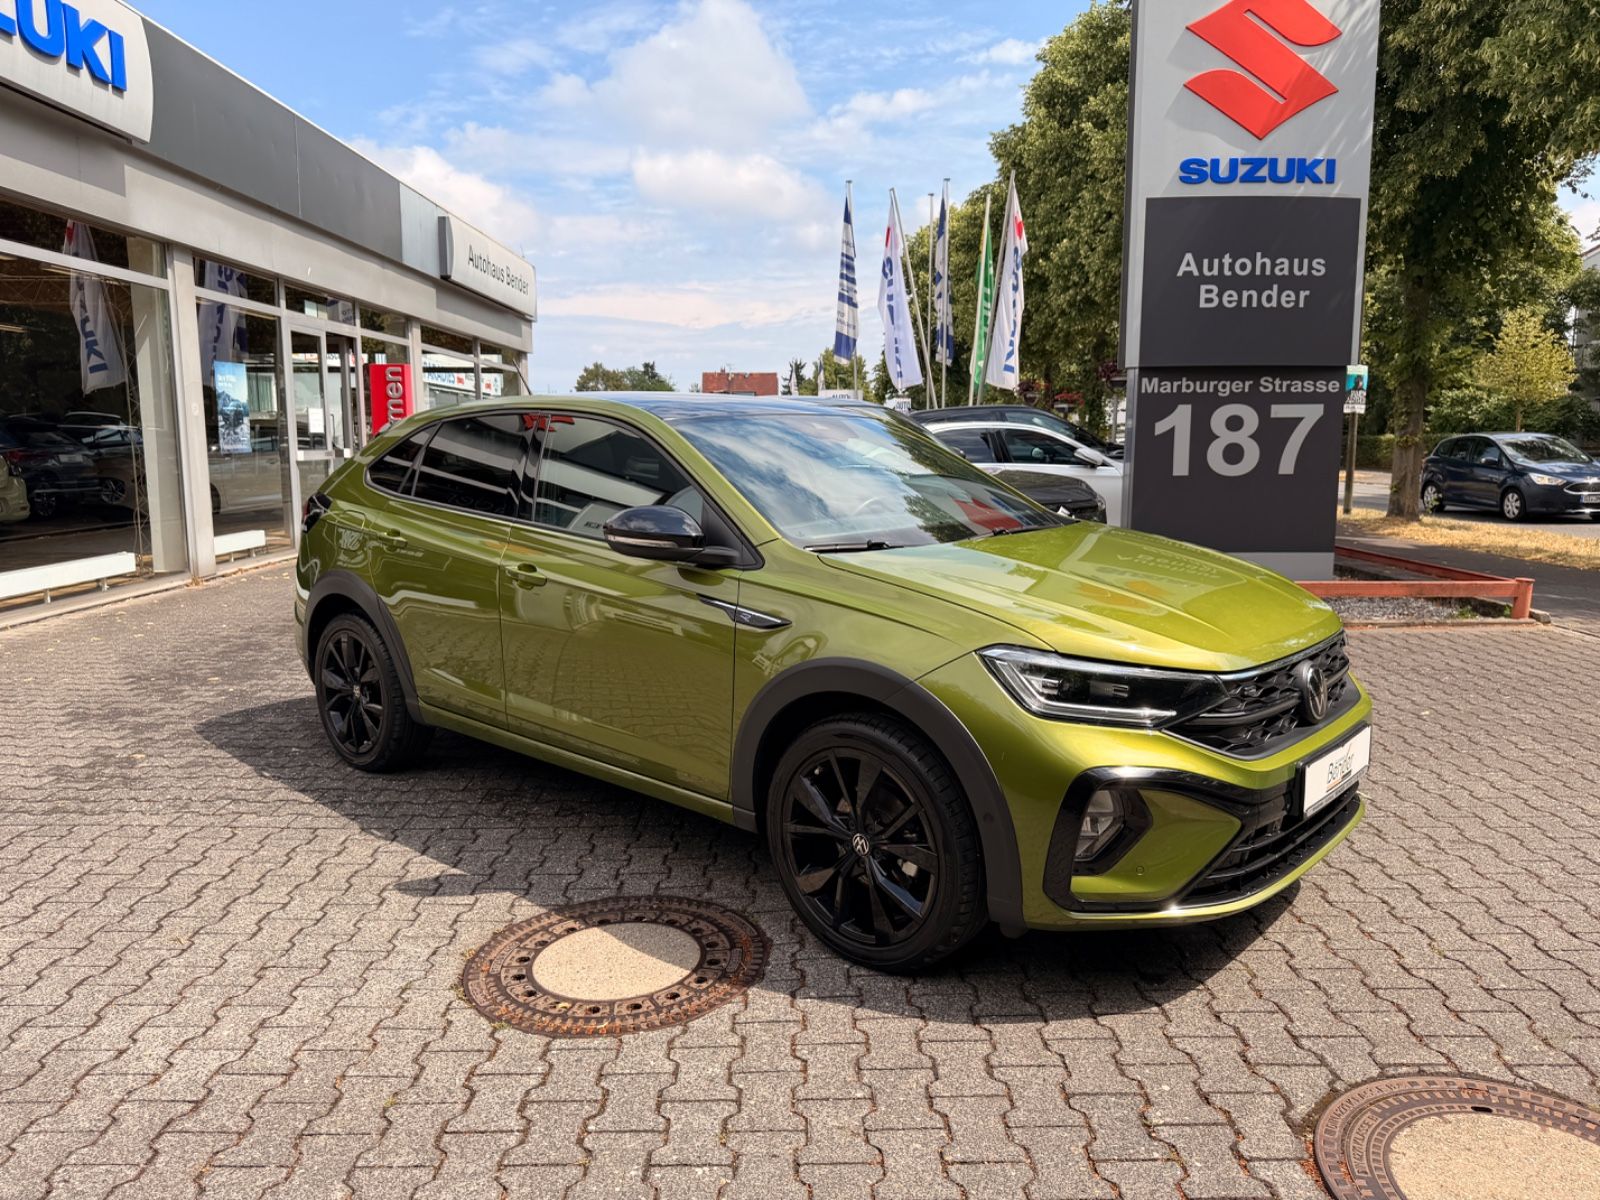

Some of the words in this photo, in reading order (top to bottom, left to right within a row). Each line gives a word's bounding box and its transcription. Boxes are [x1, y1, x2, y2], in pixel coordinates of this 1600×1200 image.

[0, 0, 127, 91] UKI
[1179, 157, 1337, 184] SUZUKI
[468, 244, 505, 283] Autohaus
[506, 265, 529, 296] Bender
[1177, 252, 1326, 277] Autohaus
[1199, 284, 1310, 309] Bender
[1141, 377, 1253, 397] Marburger
[1259, 376, 1340, 393] Strasse
[1154, 403, 1325, 477] 187
